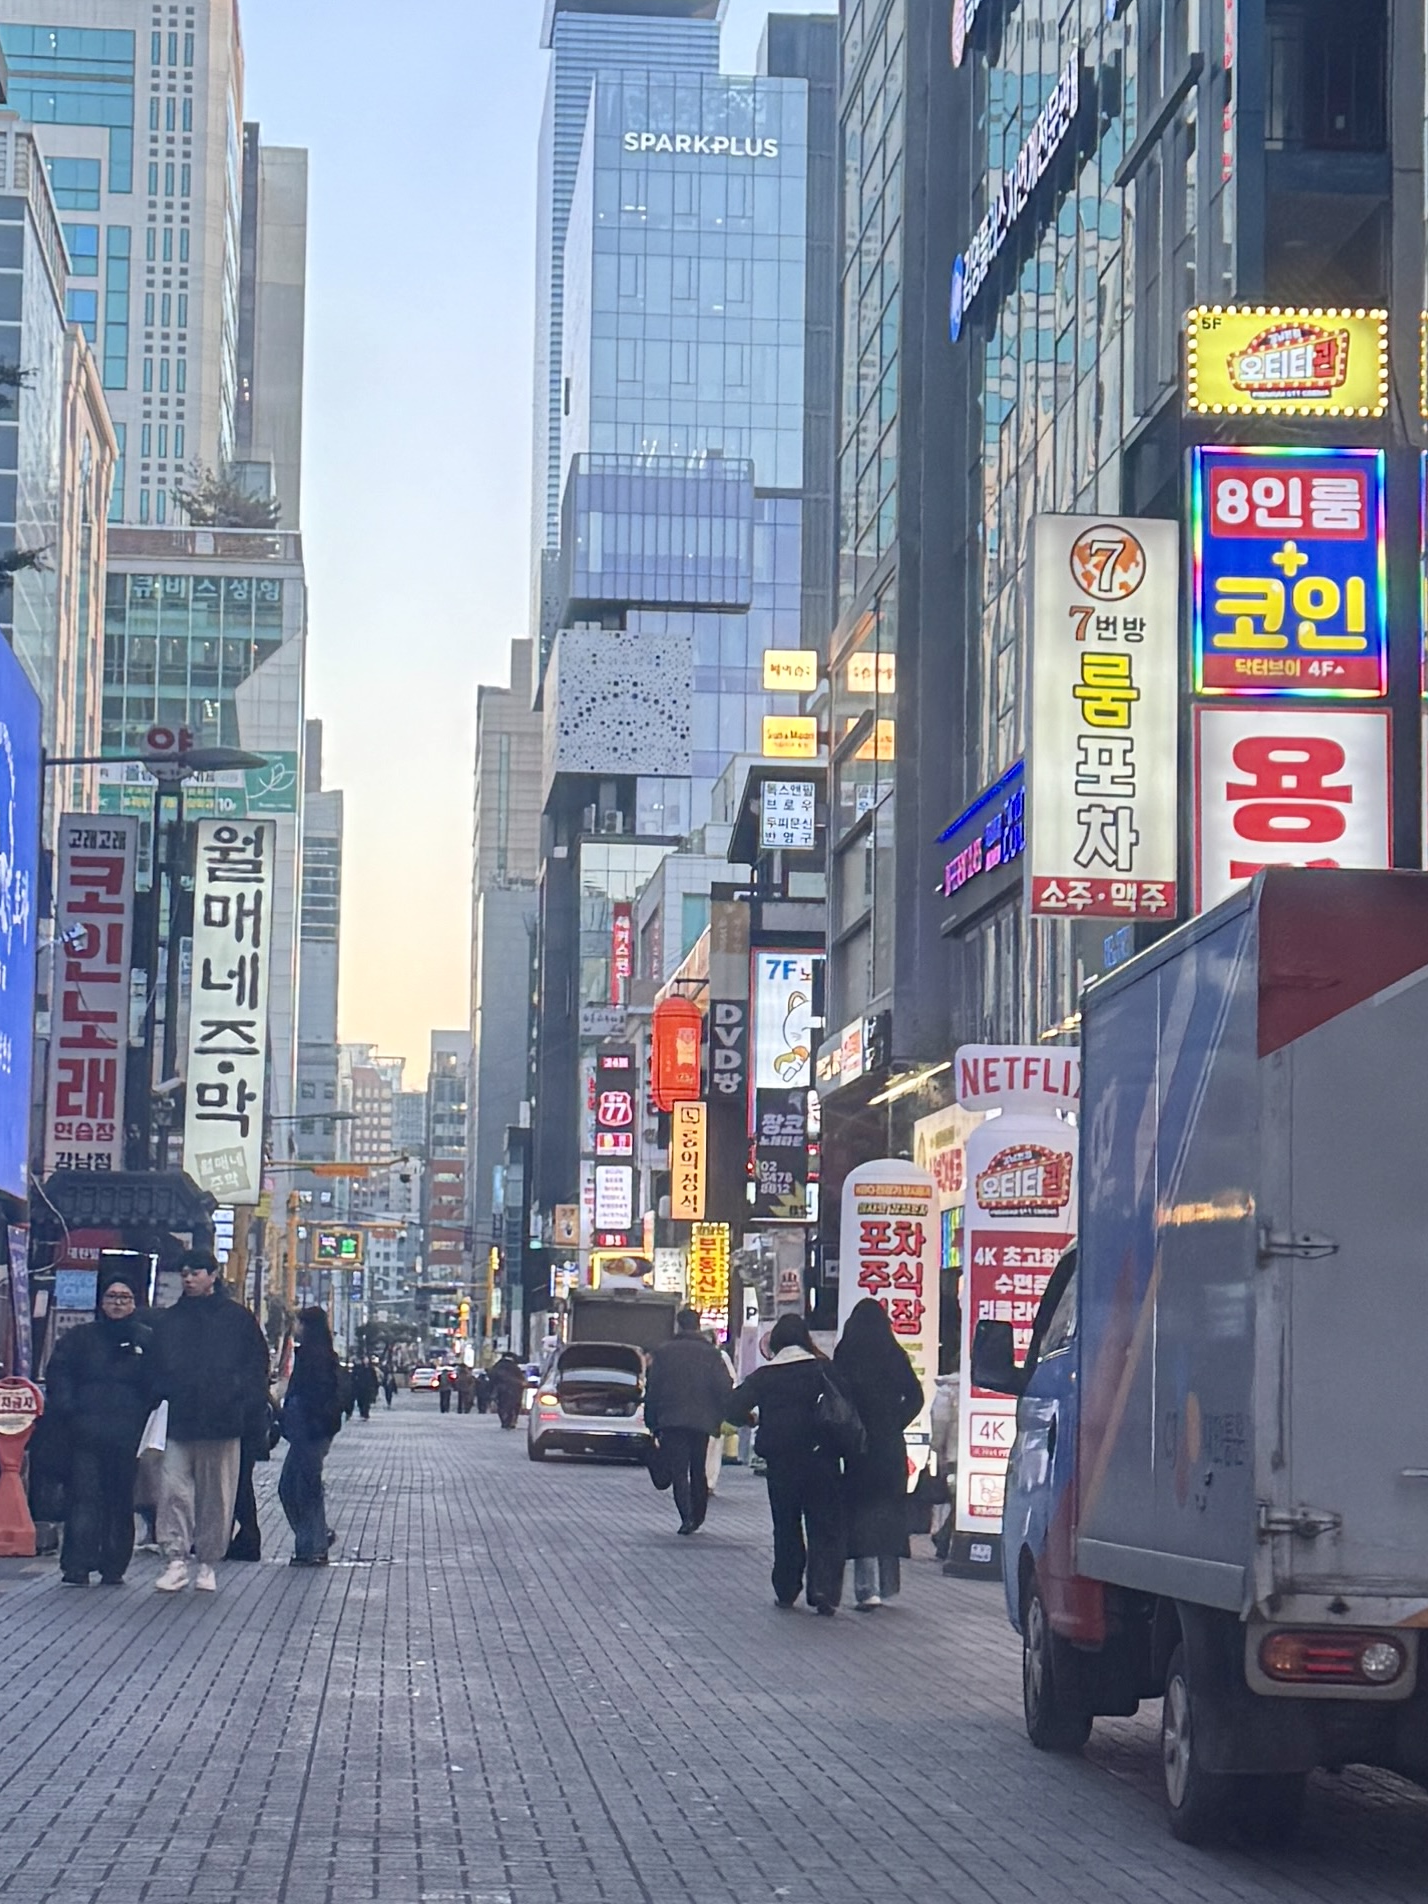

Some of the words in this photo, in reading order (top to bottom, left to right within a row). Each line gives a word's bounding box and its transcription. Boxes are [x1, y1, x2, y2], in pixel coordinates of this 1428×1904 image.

[1201, 316, 1223, 331] 5F
[1068, 604, 1147, 644] 7번방
[1212, 576, 1368, 651] 코인
[1234, 658, 1301, 677] 닥터브이
[1308, 659, 1334, 676] 4F
[1072, 651, 1140, 873] 룸포차
[1225, 736, 1353, 871] 용
[765, 959, 798, 981] 7F
[55, 856, 126, 1119] 코인노래
[192, 824, 266, 1140] 월매네주막
[603, 1103, 627, 1121] 77
[53, 1120, 117, 1143] 연습장
[54, 1150, 113, 1171] 강남점
[760, 1160, 778, 1173] 02
[858, 1220, 927, 1258] 포차
[974, 1247, 997, 1266] 4K
[1003, 1246, 1065, 1268] 초고화
[857, 1260, 923, 1297] 주식
[746, 1307, 758, 1320] P
[980, 1421, 1005, 1441] 4K
